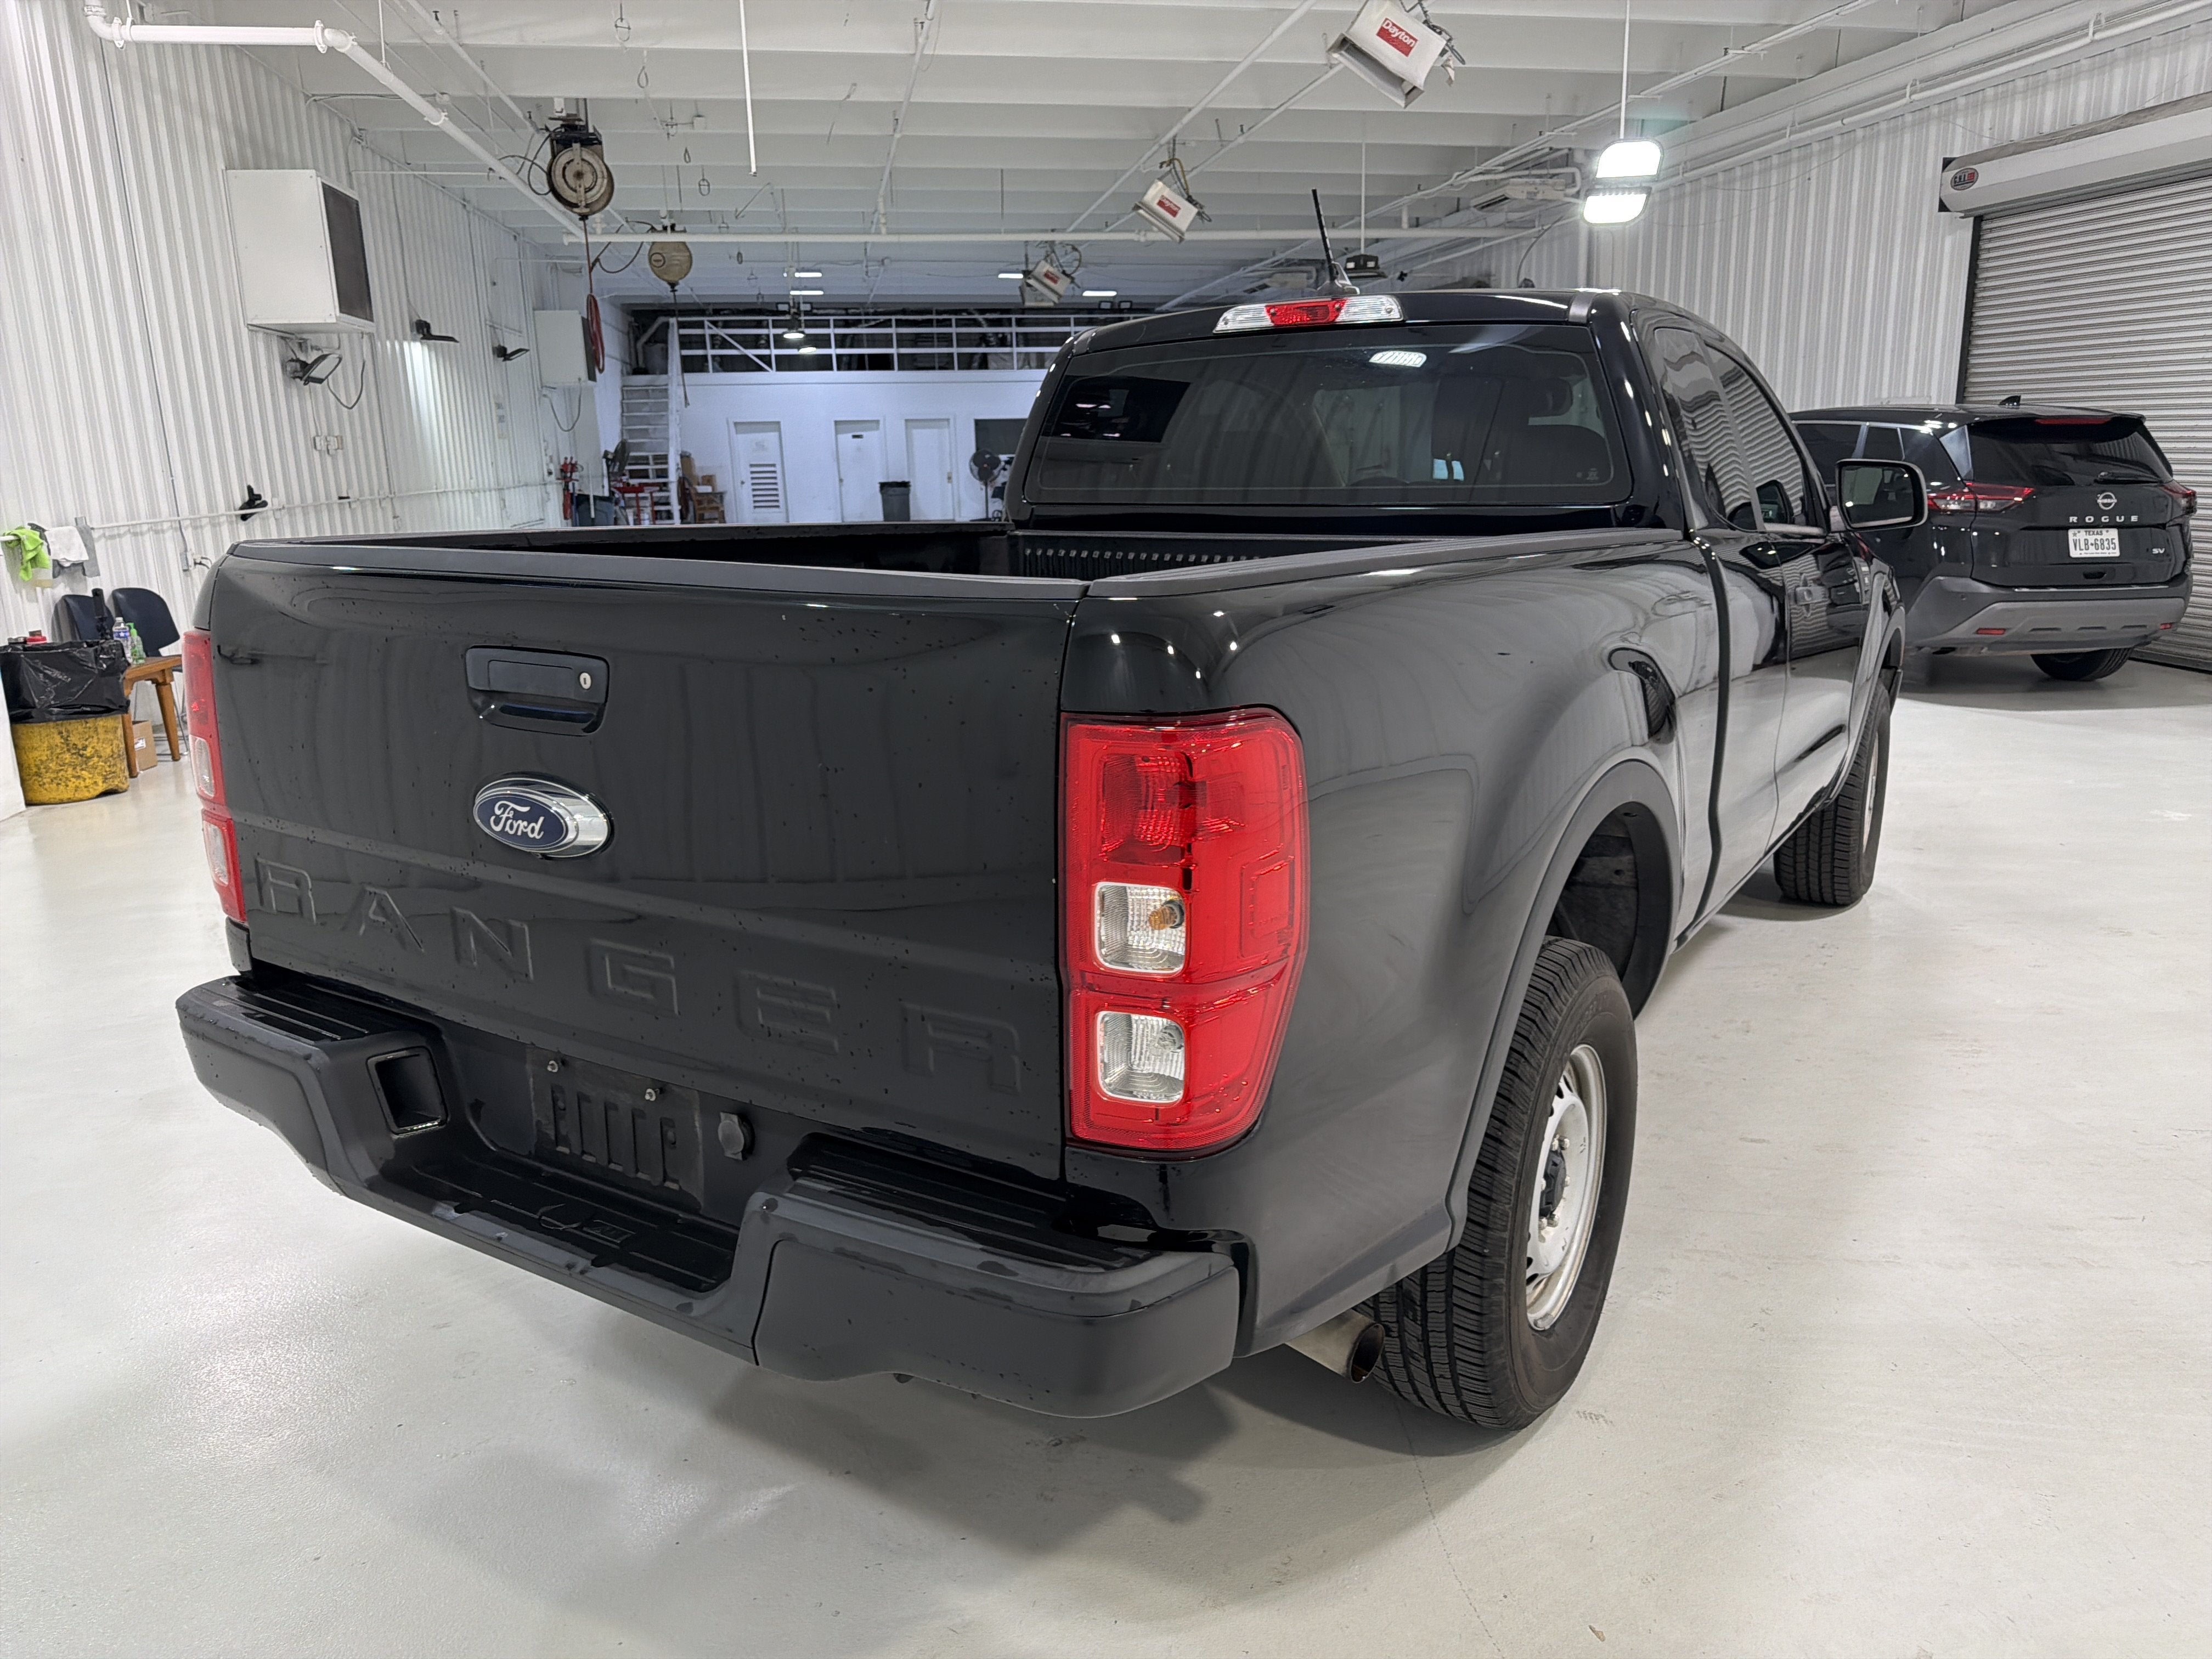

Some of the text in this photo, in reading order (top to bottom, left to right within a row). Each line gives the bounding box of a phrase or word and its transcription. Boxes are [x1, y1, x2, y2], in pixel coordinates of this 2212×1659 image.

[1383, 20, 1415, 47] Dayton
[490, 800, 544, 839] Ford
[254, 857, 1021, 1096] RANGER
